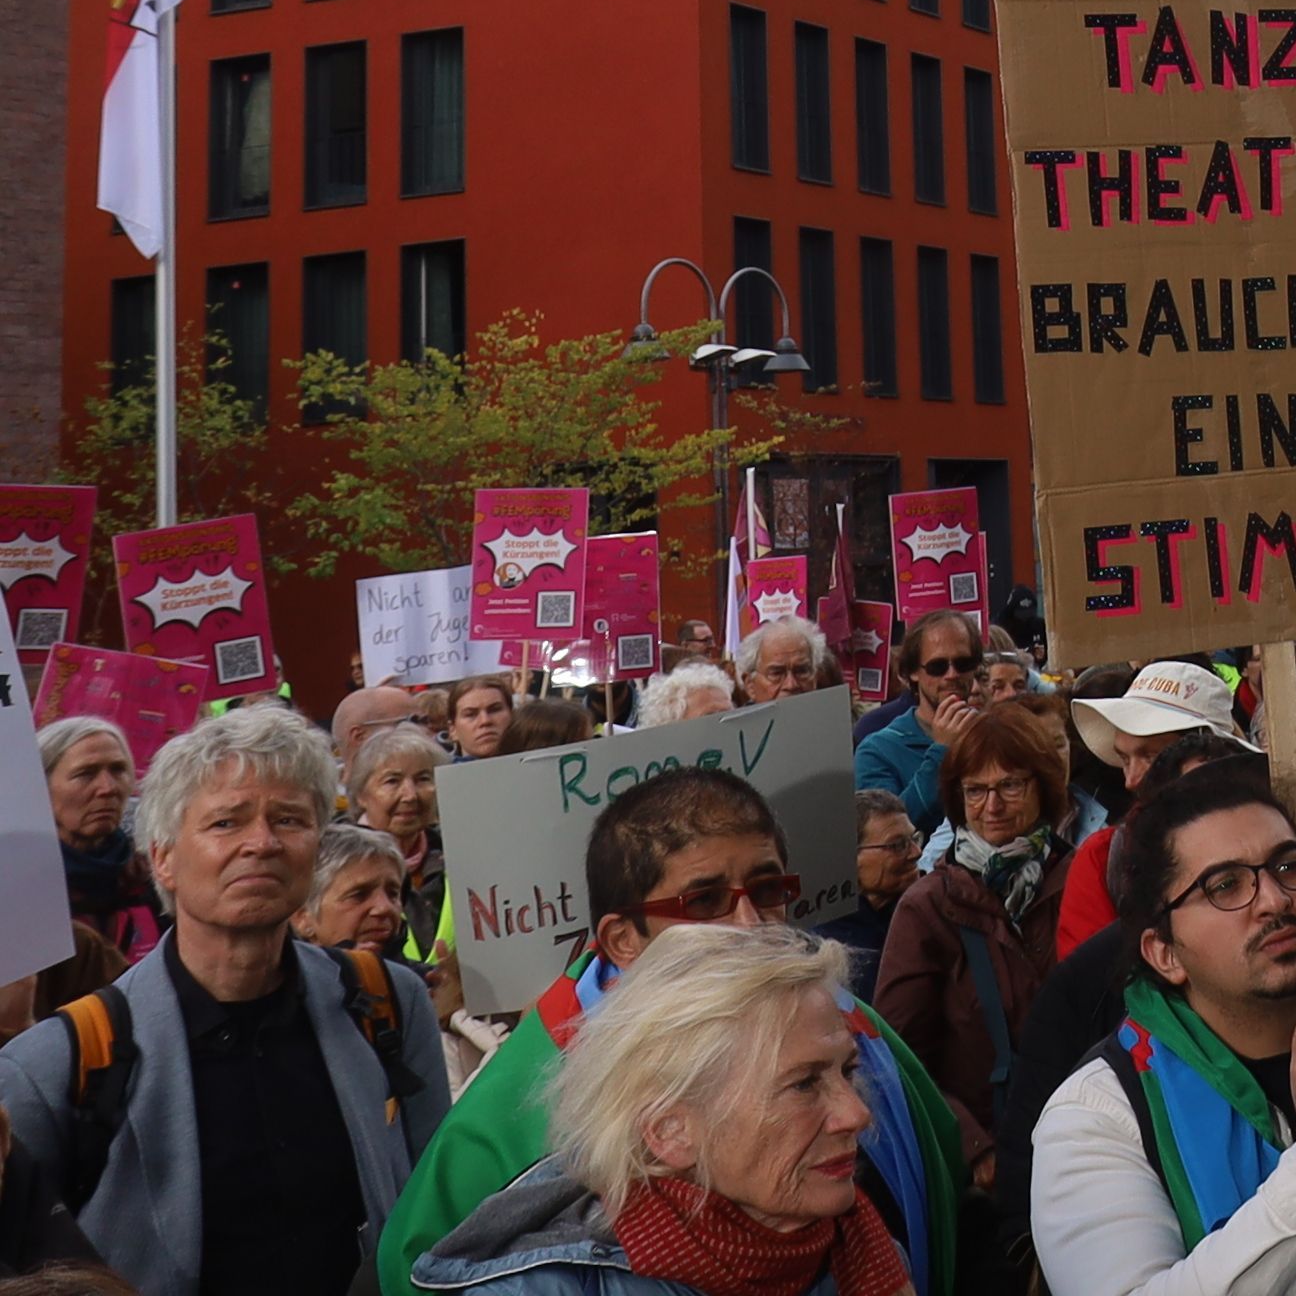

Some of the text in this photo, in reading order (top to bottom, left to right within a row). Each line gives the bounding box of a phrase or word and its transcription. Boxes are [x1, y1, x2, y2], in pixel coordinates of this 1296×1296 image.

[543, 539, 559, 548] die
[367, 586, 423, 614] Nicht
[372, 626, 403, 647] der
[393, 640, 470, 675] sparen!
[1147, 676, 1181, 696] CUBA
[466, 880, 579, 943] Nicht
